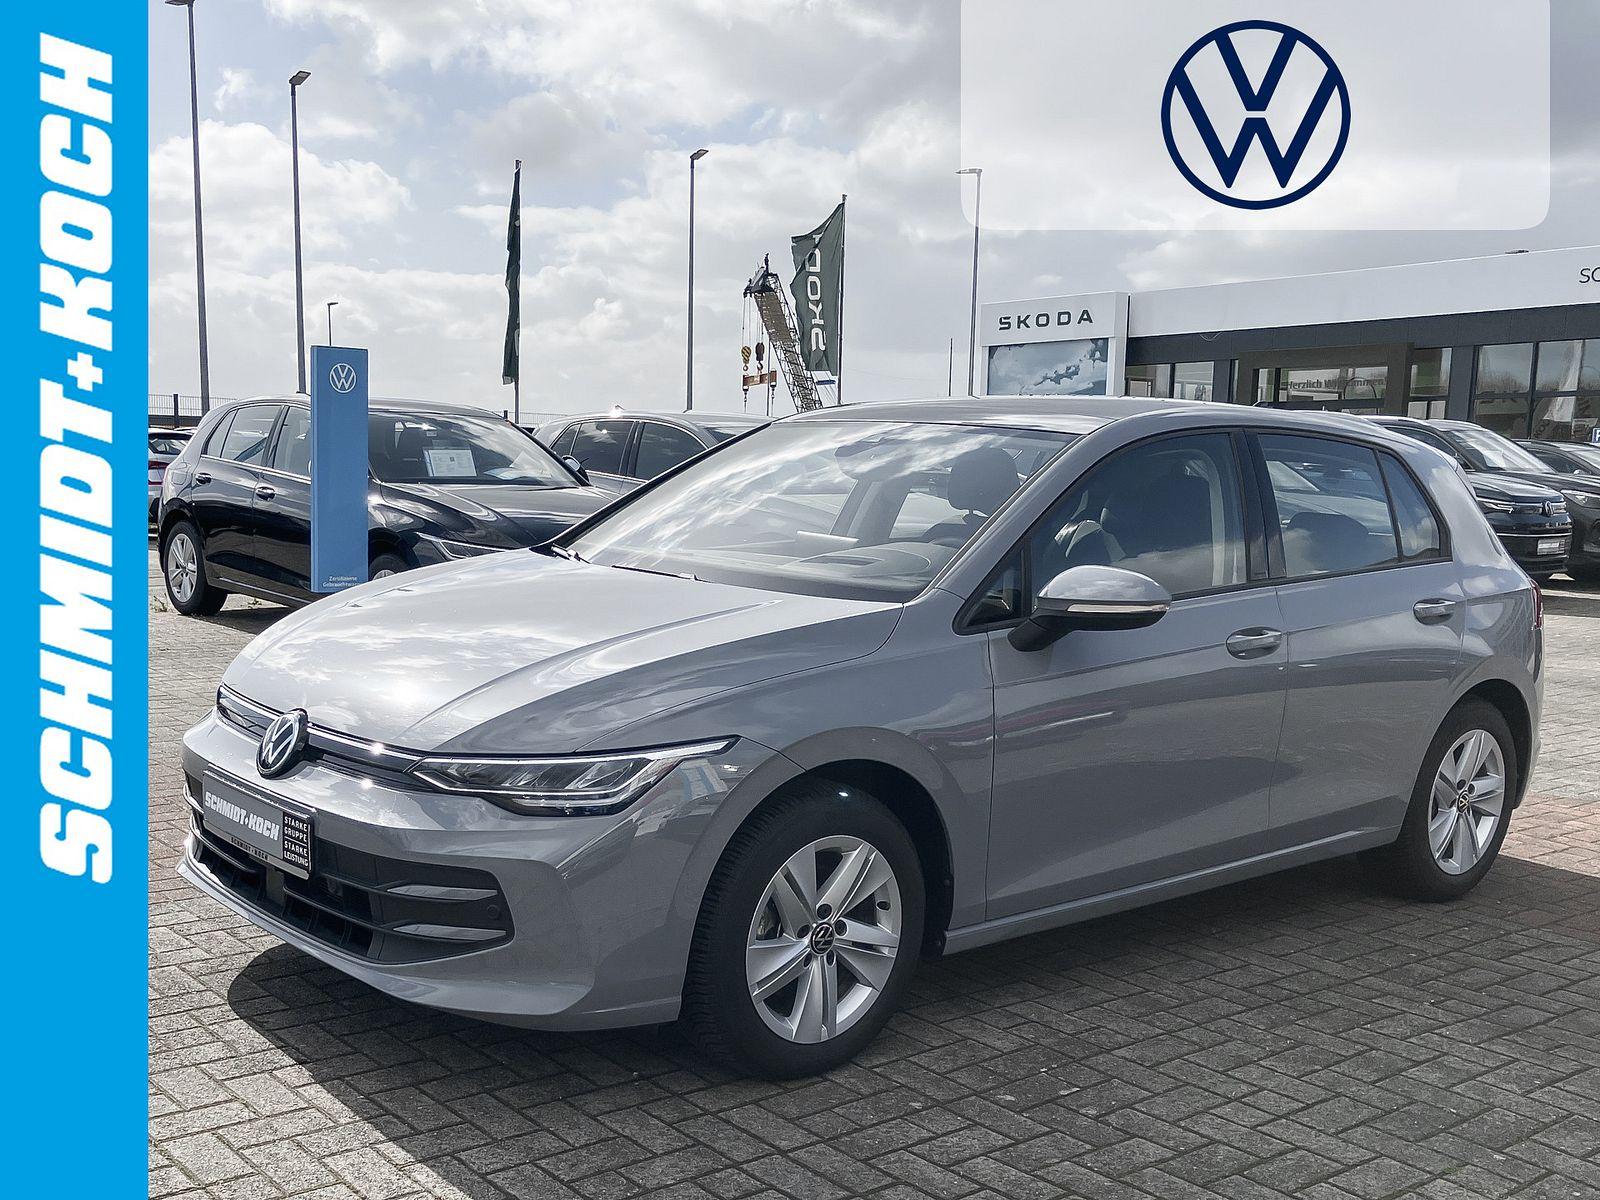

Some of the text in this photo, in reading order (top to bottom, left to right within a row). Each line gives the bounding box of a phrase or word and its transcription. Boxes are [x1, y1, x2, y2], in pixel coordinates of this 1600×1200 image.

[284, 815, 308, 832] STARKE
[284, 826, 307, 842] GRUPPE
[284, 840, 308, 857] STARKE
[284, 850, 309, 867] LEISTUNG
